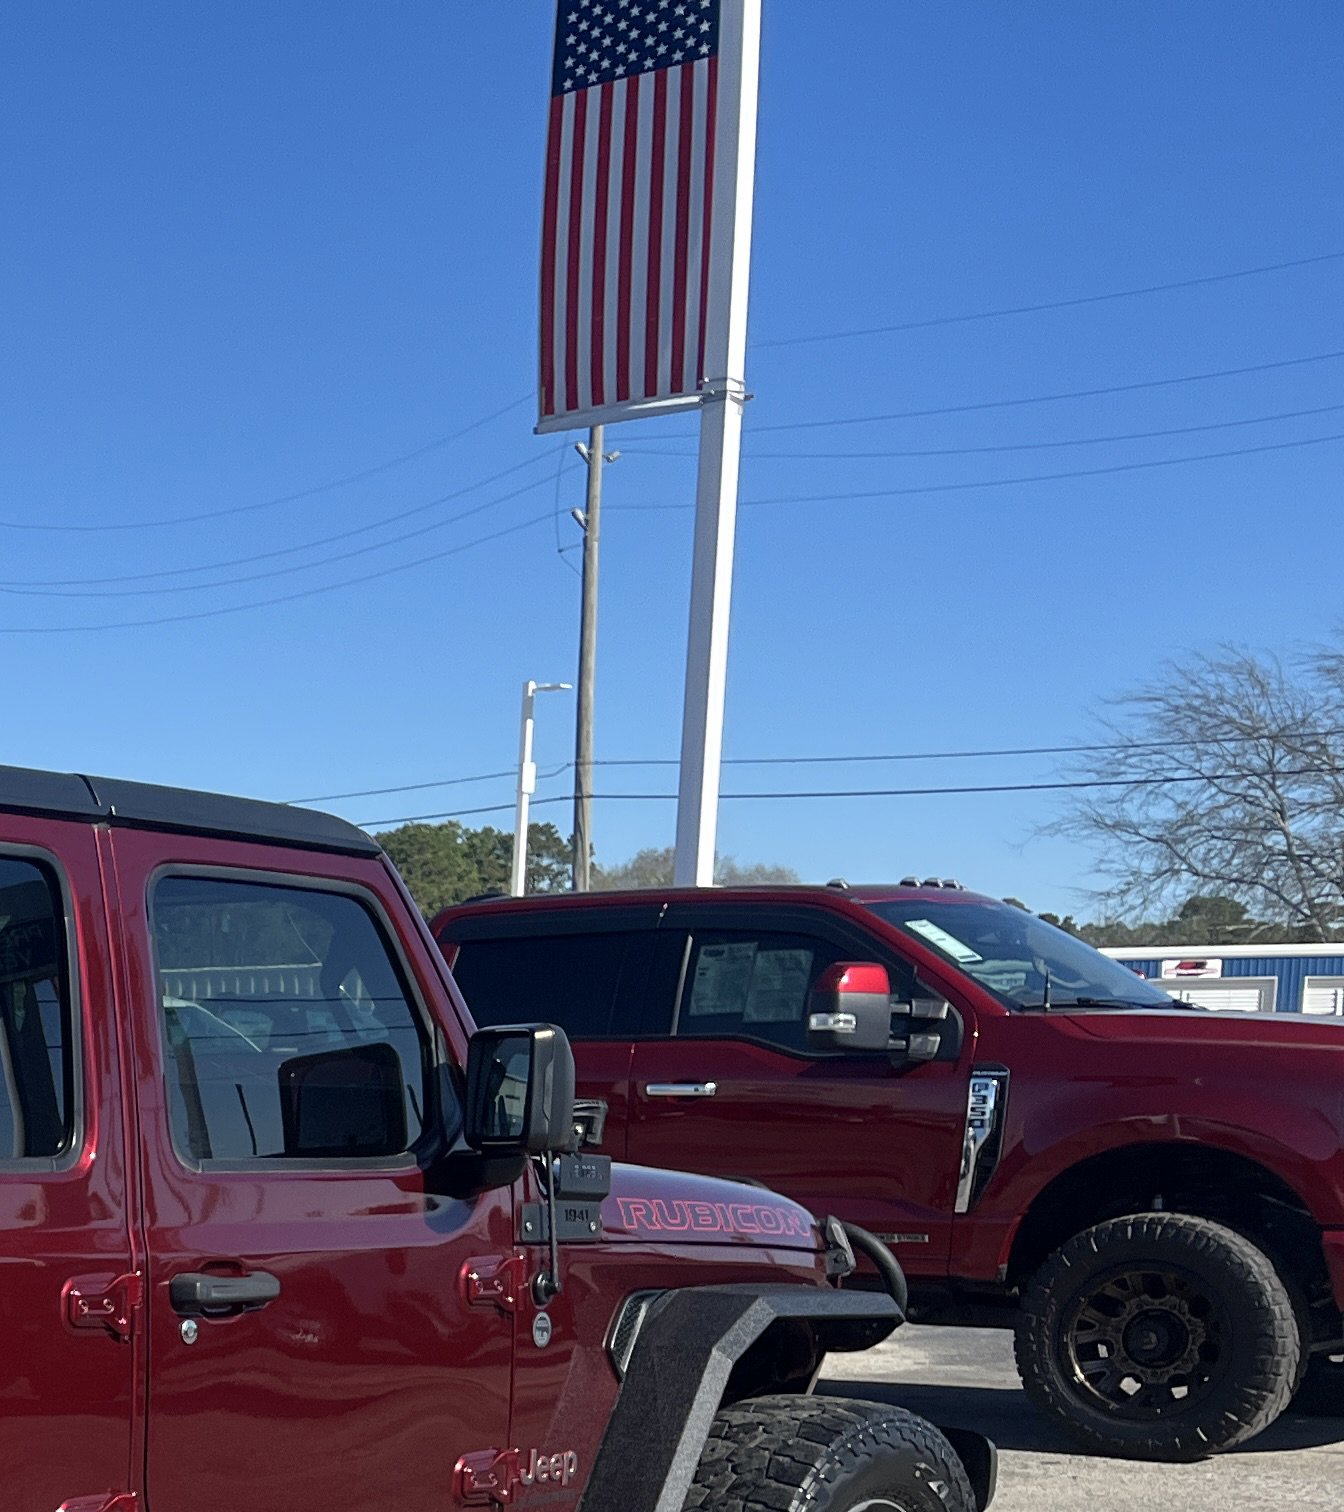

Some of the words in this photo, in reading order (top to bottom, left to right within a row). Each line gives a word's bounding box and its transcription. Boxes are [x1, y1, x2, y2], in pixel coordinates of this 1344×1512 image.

[564, 1208, 589, 1222] 1941
[616, 1197, 811, 1237] RUBICON
[519, 1448, 578, 1487] Jeep
